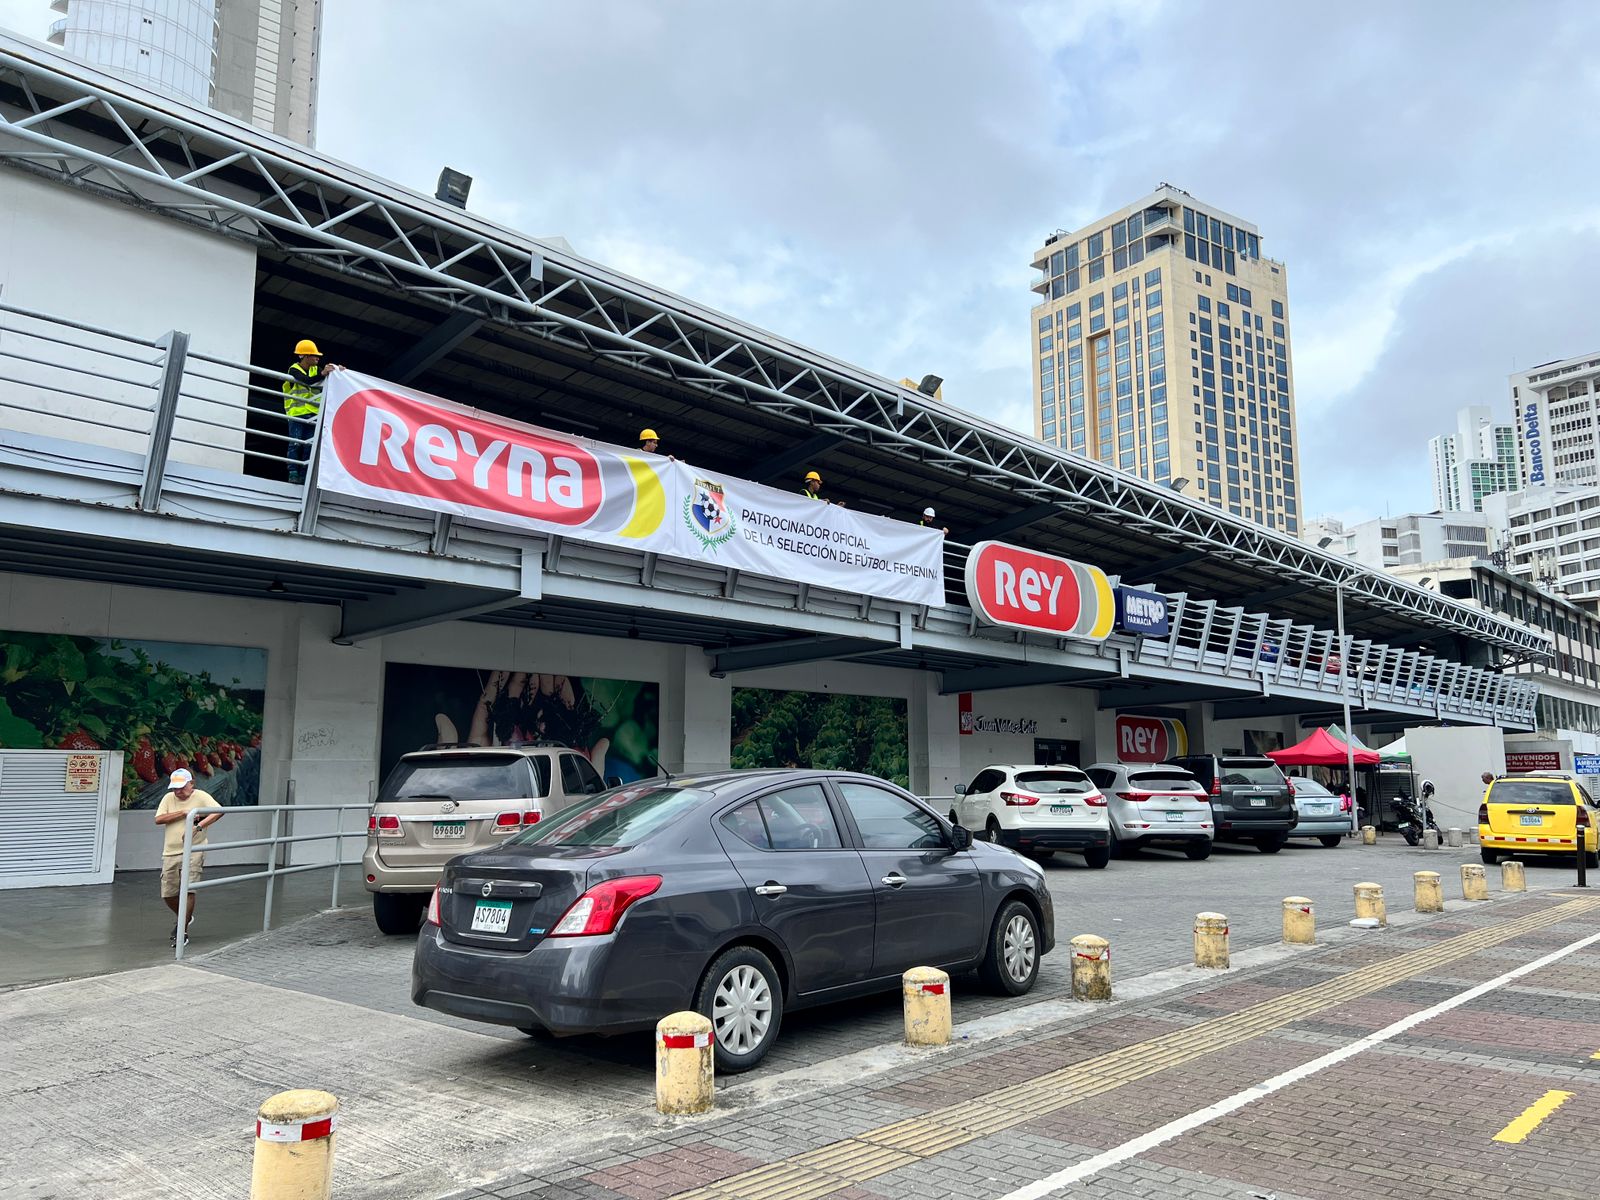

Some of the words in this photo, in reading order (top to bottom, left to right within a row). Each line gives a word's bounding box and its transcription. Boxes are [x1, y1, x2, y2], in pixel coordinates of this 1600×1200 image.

[1524, 403, 1540, 439] Delta
[1530, 440, 1544, 482] Banco
[741, 508, 830, 541] PATROCINADOR
[832, 531, 870, 550] OFICIAL
[744, 528, 758, 543] DE
[760, 532, 774, 548] LA
[777, 537, 837, 561] SELECCIÓN
[839, 550, 853, 565] DE
[854, 553, 892, 573] FÚTBOL
[1126, 595, 1164, 623] METRO
[1127, 615, 1152, 626] FARMACIA
[434, 825, 464, 835] 696809
[475, 907, 507, 925] AS7804
